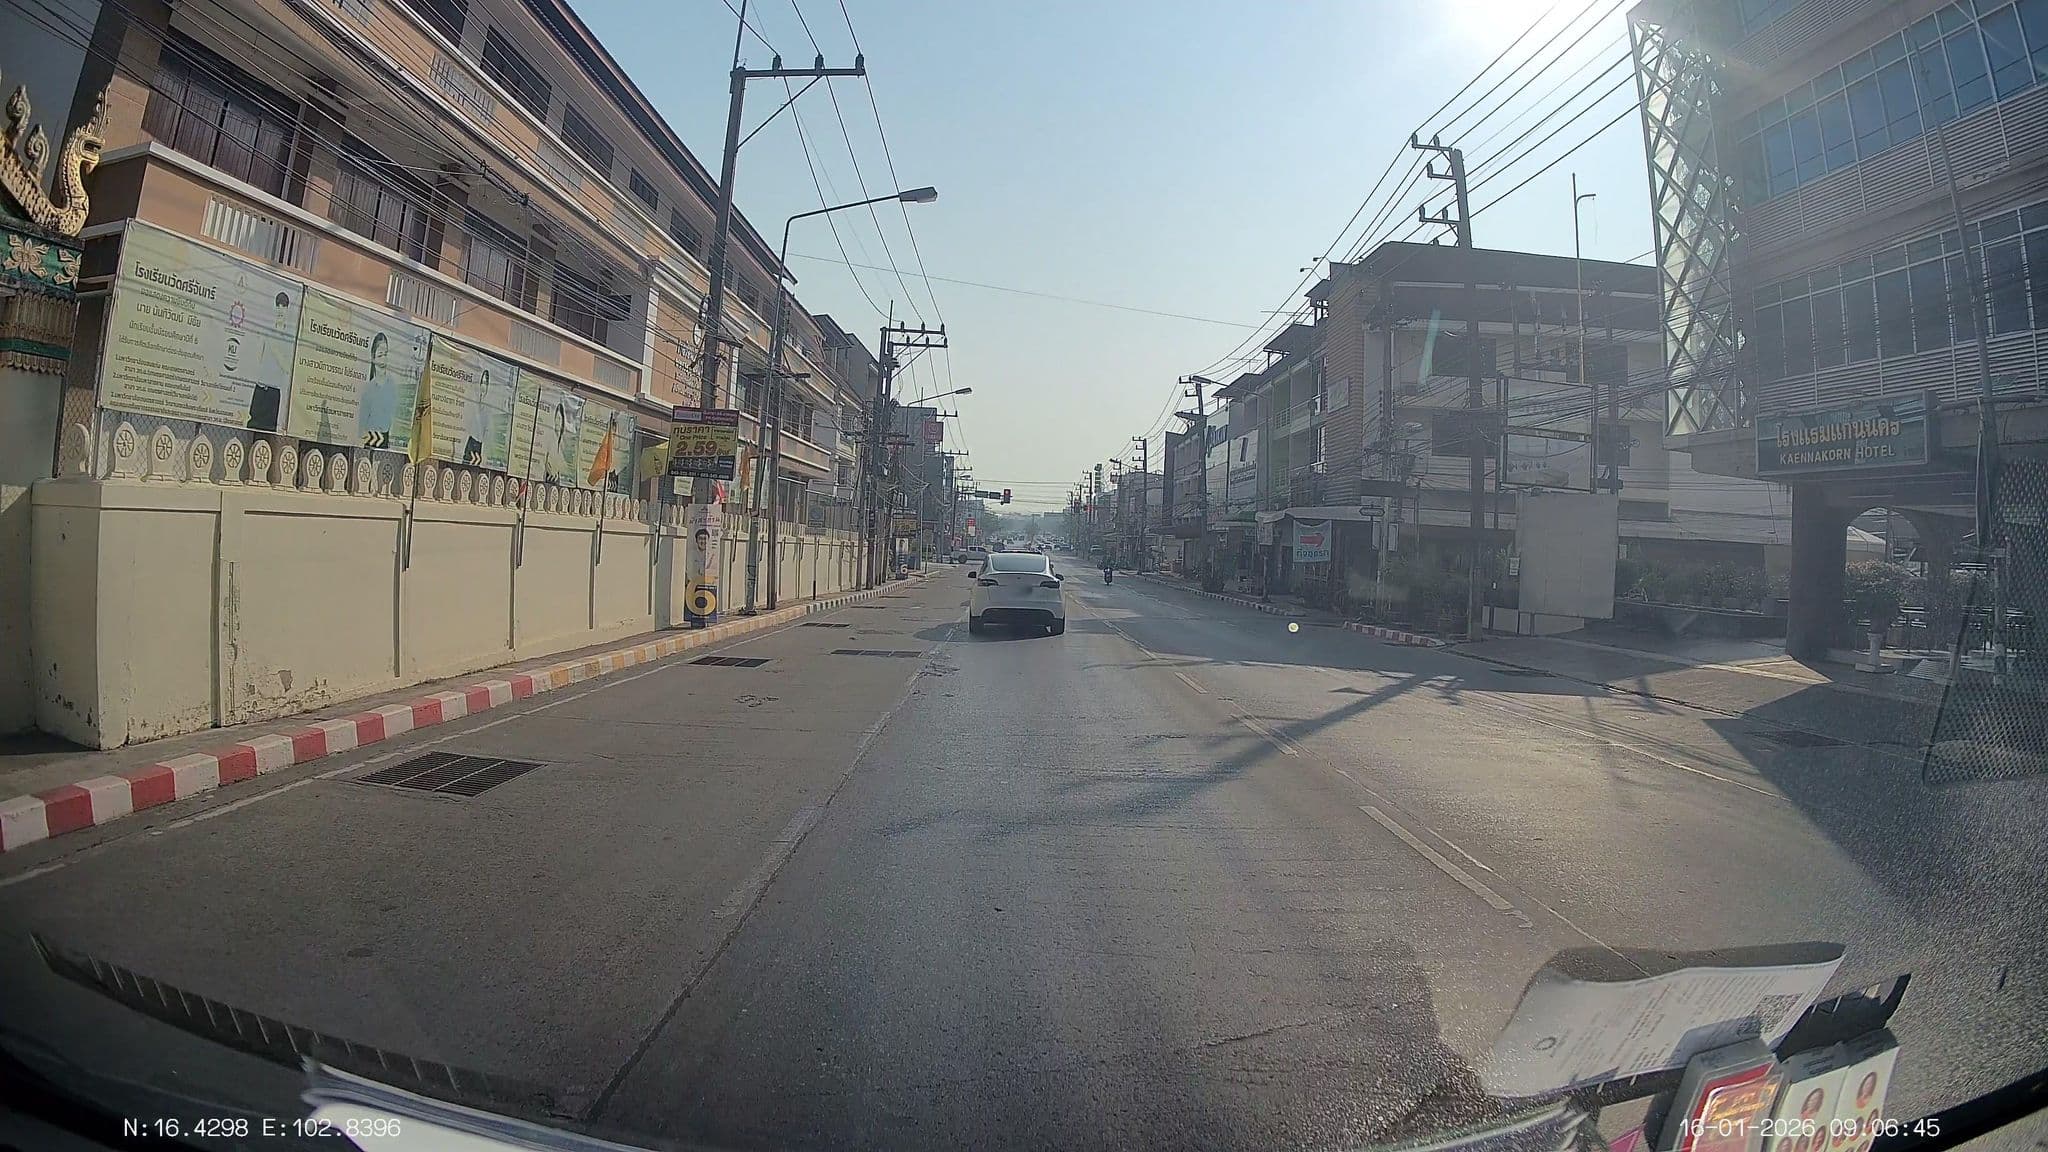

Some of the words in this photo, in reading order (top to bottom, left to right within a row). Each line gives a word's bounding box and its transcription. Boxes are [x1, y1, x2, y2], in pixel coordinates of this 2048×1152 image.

[134, 261, 217, 301] โรงเรียนวัดศรีจันทร์
[310, 318, 370, 349] โรงเรียนวัดศรีจันทร์
[675, 441, 717, 456] 2.59
[1779, 448, 1851, 465] KAENNAKORN
[1855, 444, 1895, 459] HOTEL
[685, 578, 717, 616] 6
